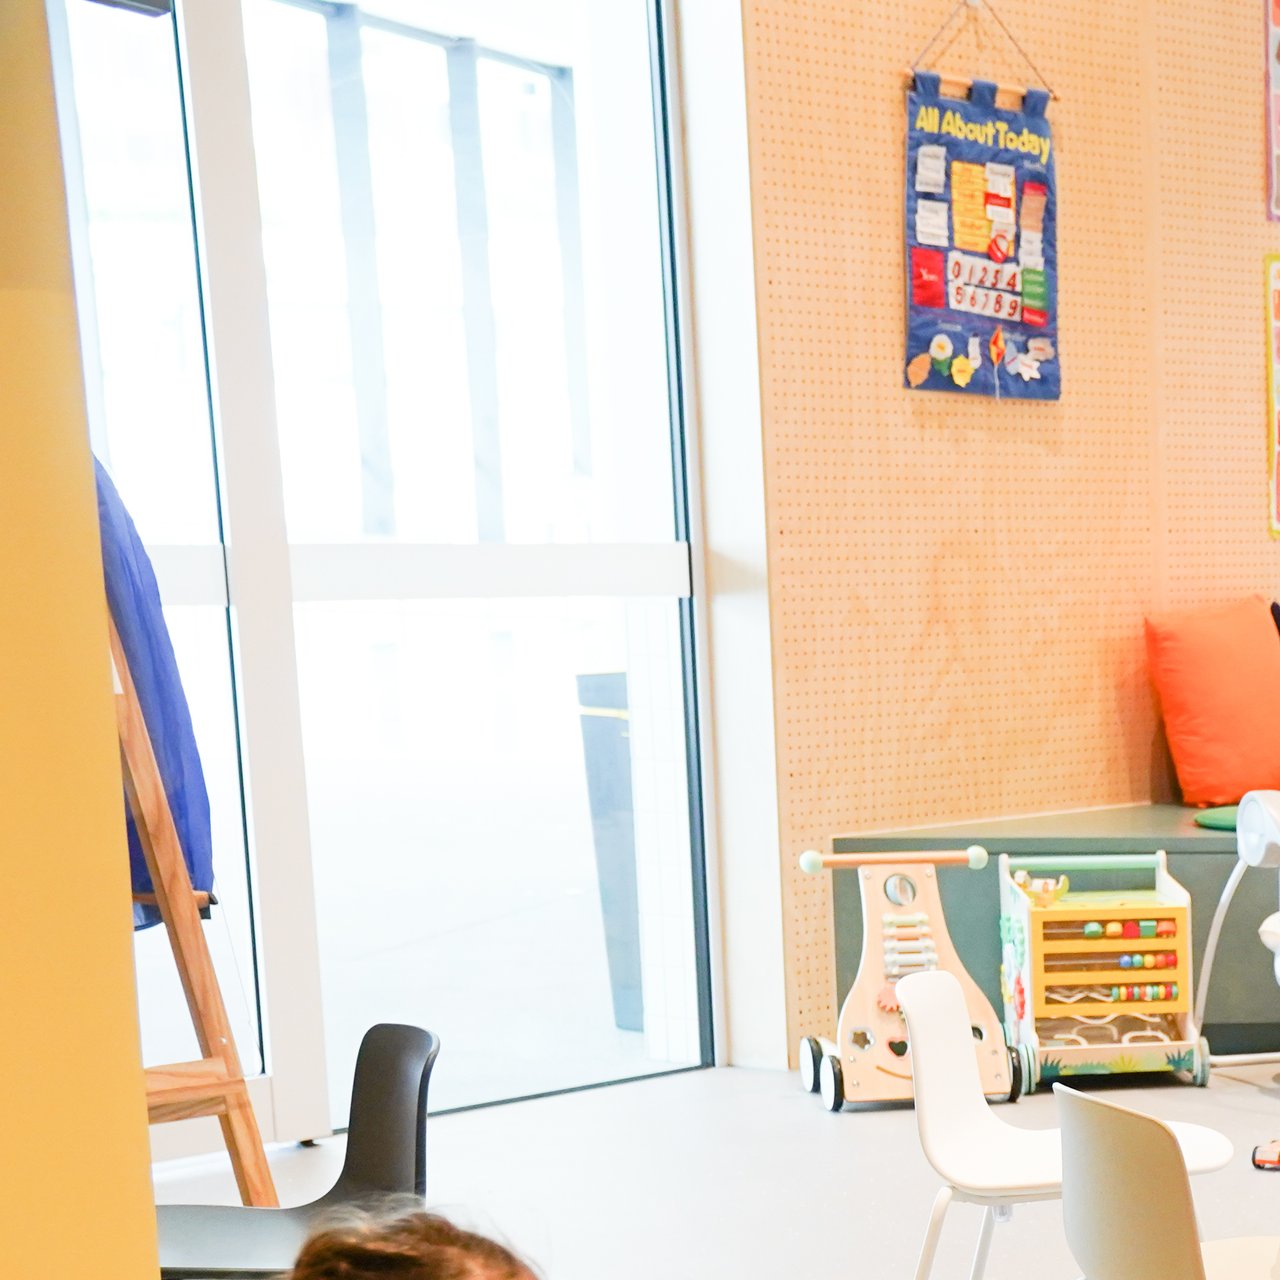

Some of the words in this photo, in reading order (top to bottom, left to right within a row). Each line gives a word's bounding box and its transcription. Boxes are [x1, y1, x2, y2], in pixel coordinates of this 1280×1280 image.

[914, 105, 940, 134] All
[941, 110, 995, 147] About
[995, 121, 1050, 165] Today
[952, 261, 961, 279] 0
[978, 267, 987, 285] 2
[1006, 272, 1017, 291] 4
[994, 294, 1002, 313] 8
[1007, 300, 1018, 317] 9
